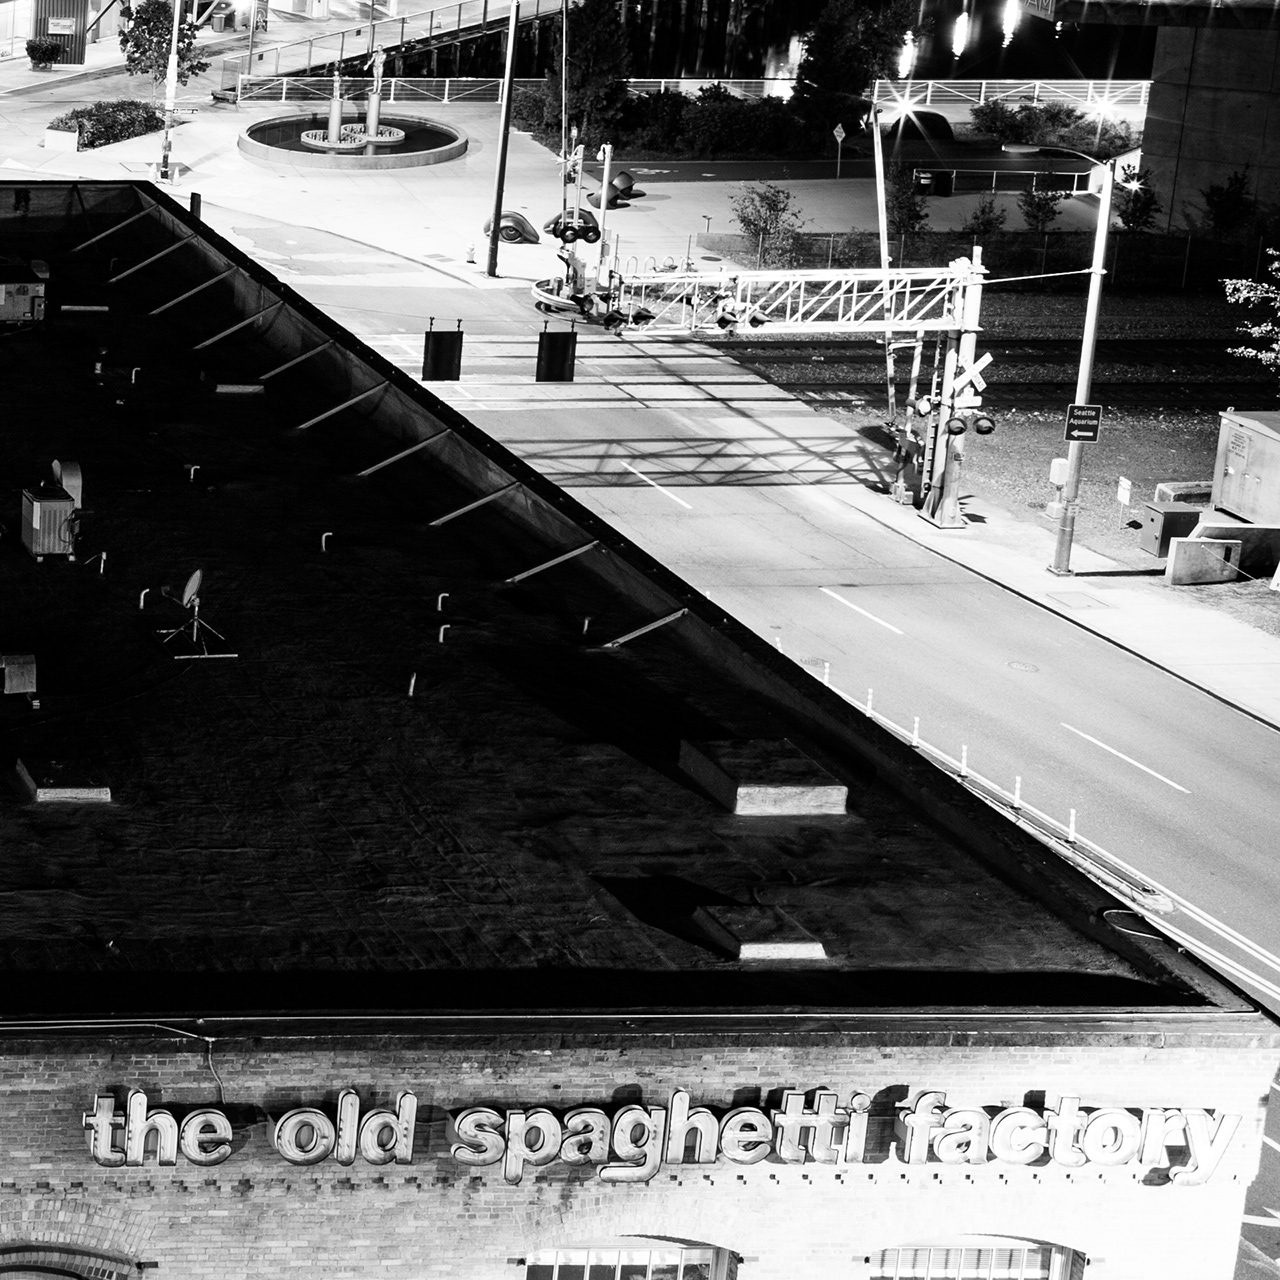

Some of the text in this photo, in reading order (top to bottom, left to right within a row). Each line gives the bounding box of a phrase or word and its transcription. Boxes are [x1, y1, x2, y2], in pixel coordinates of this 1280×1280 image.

[1073, 409, 1096, 417] Seattle
[1069, 417, 1099, 426] Aquarium
[82, 1086, 1243, 1187] the old spaghetti factory
